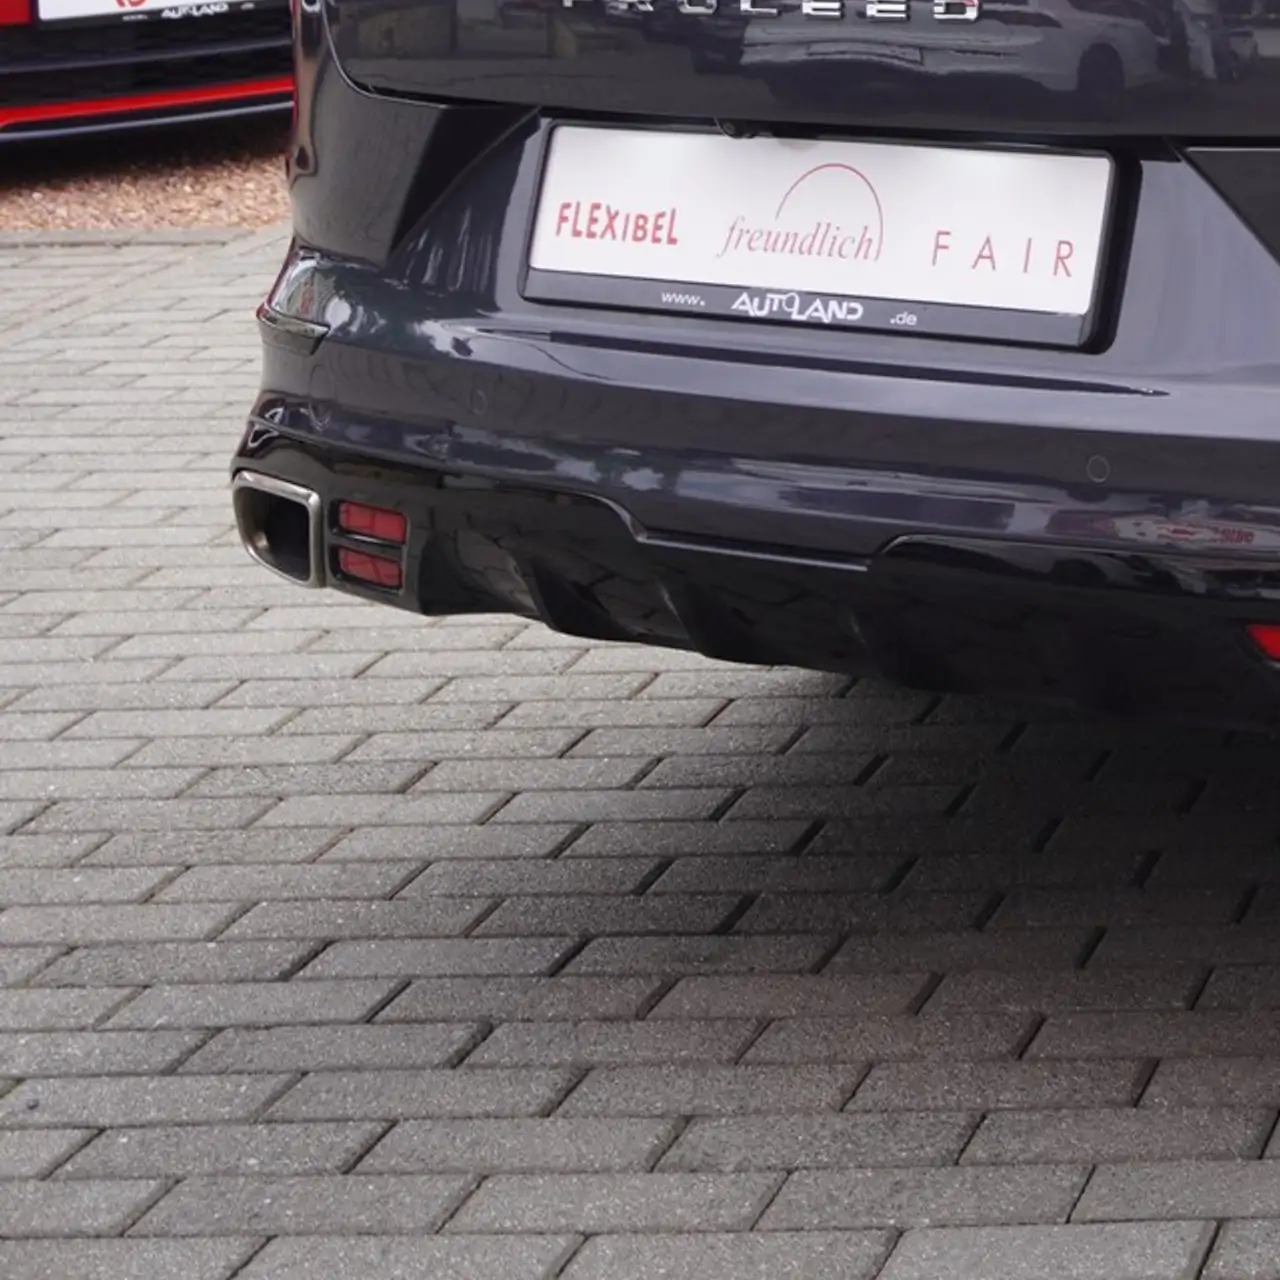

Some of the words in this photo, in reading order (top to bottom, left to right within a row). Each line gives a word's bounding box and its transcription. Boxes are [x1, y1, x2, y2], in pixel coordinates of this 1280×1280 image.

[556, 200, 680, 246] FLEXIBEL
[715, 215, 871, 260] freundlich
[931, 230, 1075, 278] FAIR
[660, 290, 706, 307] www.
[731, 291, 864, 324] AUTOLAND
